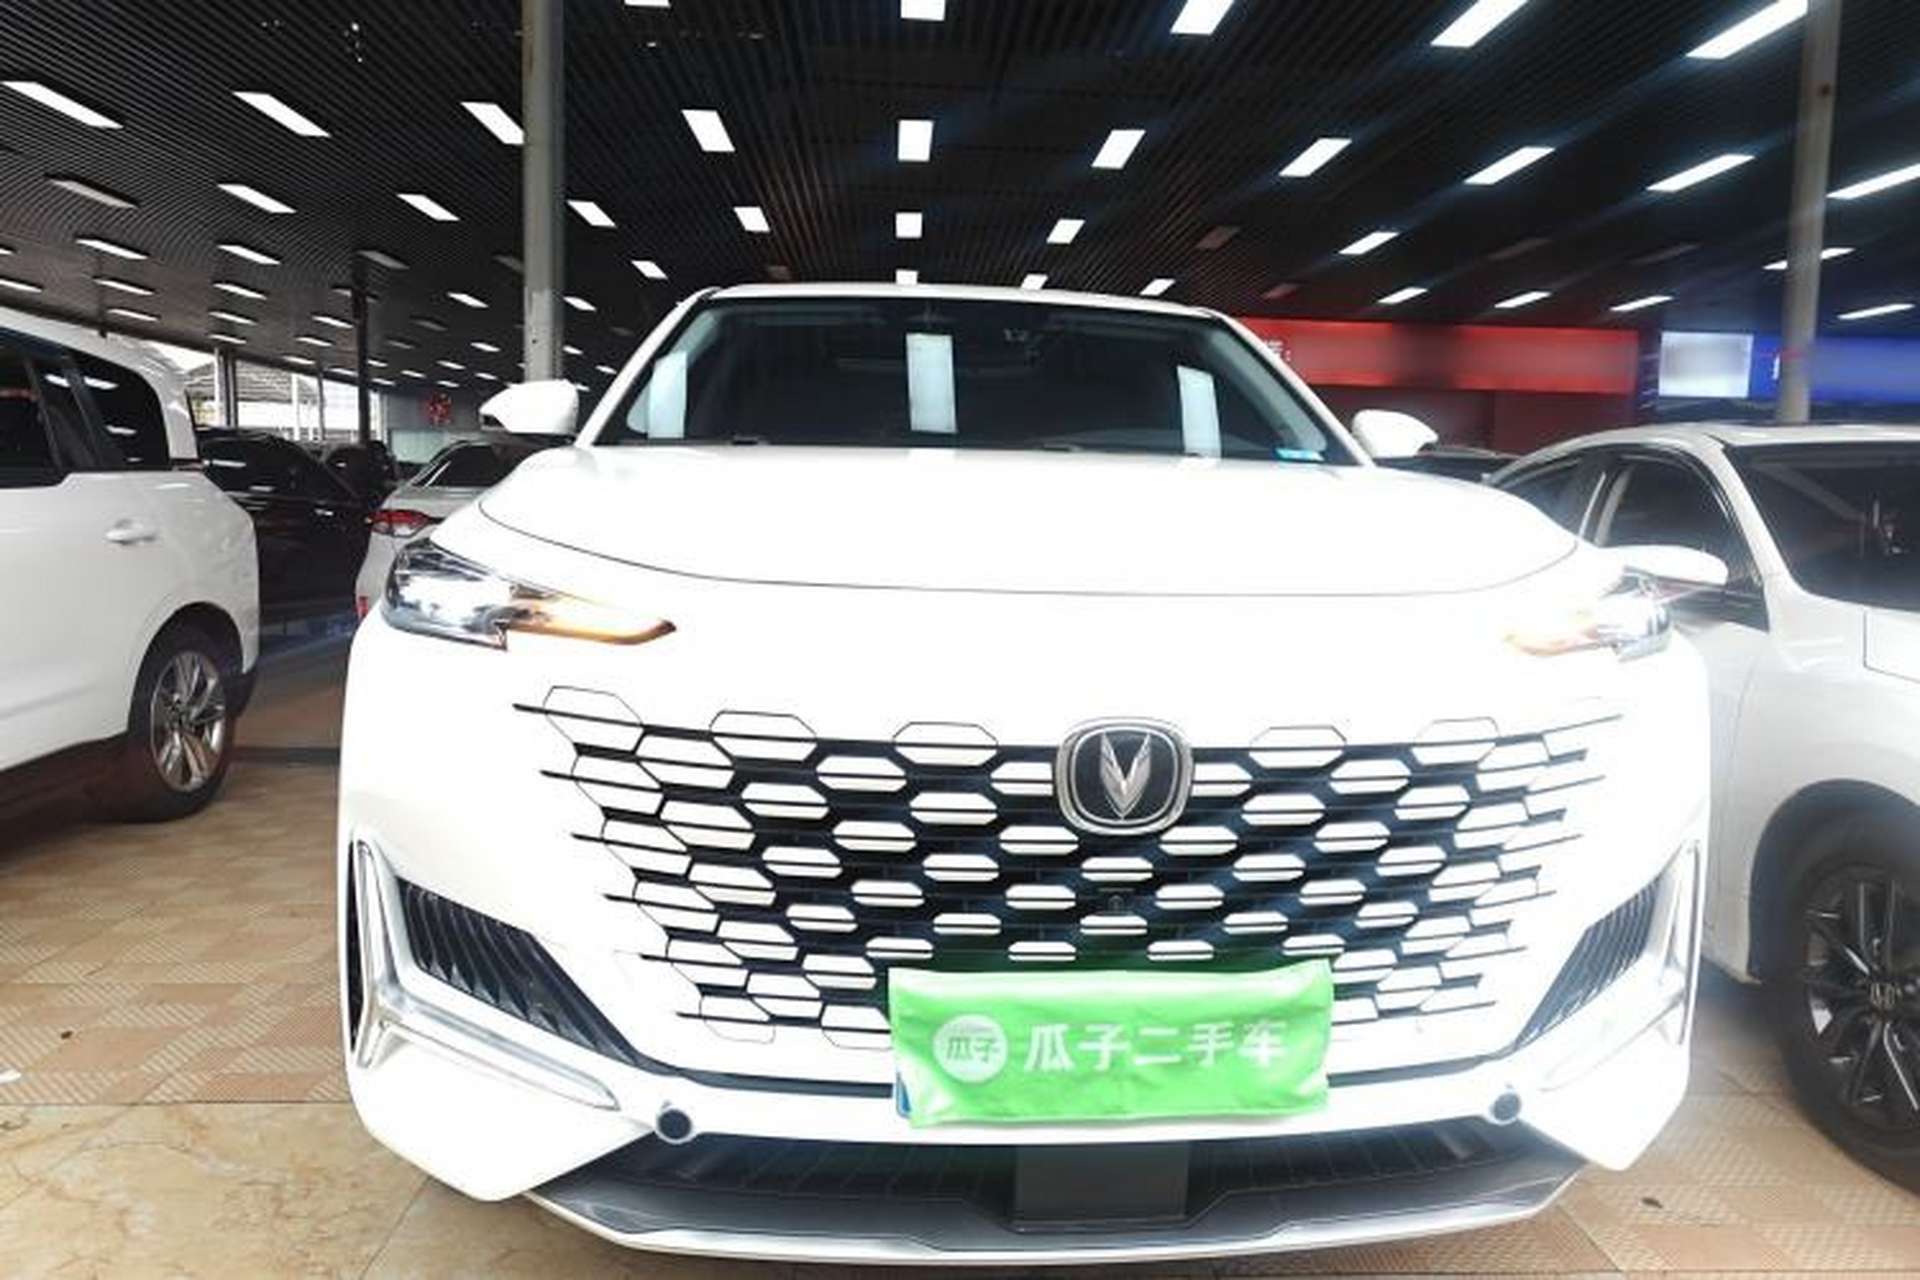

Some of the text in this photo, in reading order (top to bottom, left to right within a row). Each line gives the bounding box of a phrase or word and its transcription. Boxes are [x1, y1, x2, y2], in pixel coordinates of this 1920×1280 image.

[1026, 1020, 1284, 1071] 瓜子二手车
